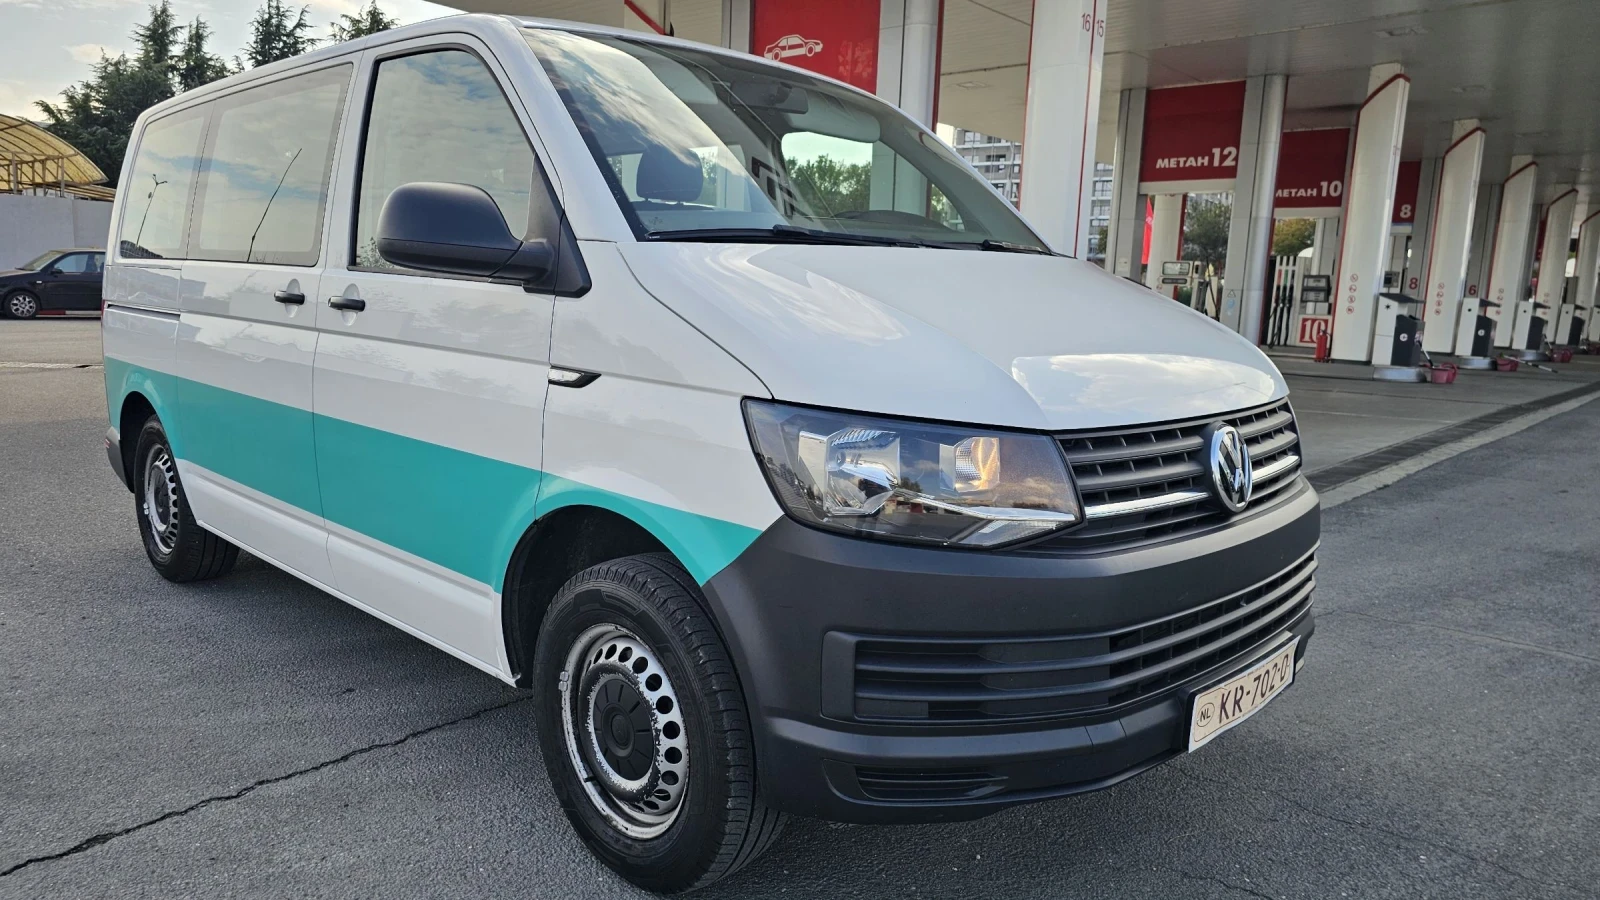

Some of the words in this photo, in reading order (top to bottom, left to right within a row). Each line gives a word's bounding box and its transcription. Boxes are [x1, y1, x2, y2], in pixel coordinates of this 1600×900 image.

[1081, 13, 1091, 32] 16
[1096, 19, 1104, 38] 15
[1155, 156, 1209, 169] МЕТАН
[1212, 146, 1237, 167] 12
[1320, 180, 1342, 197] 10
[1400, 204, 1411, 218] 8
[1408, 277, 1418, 290] 8
[1468, 284, 1477, 296] 6
[1301, 319, 1326, 343] 10
[1200, 708, 1211, 722] NL
